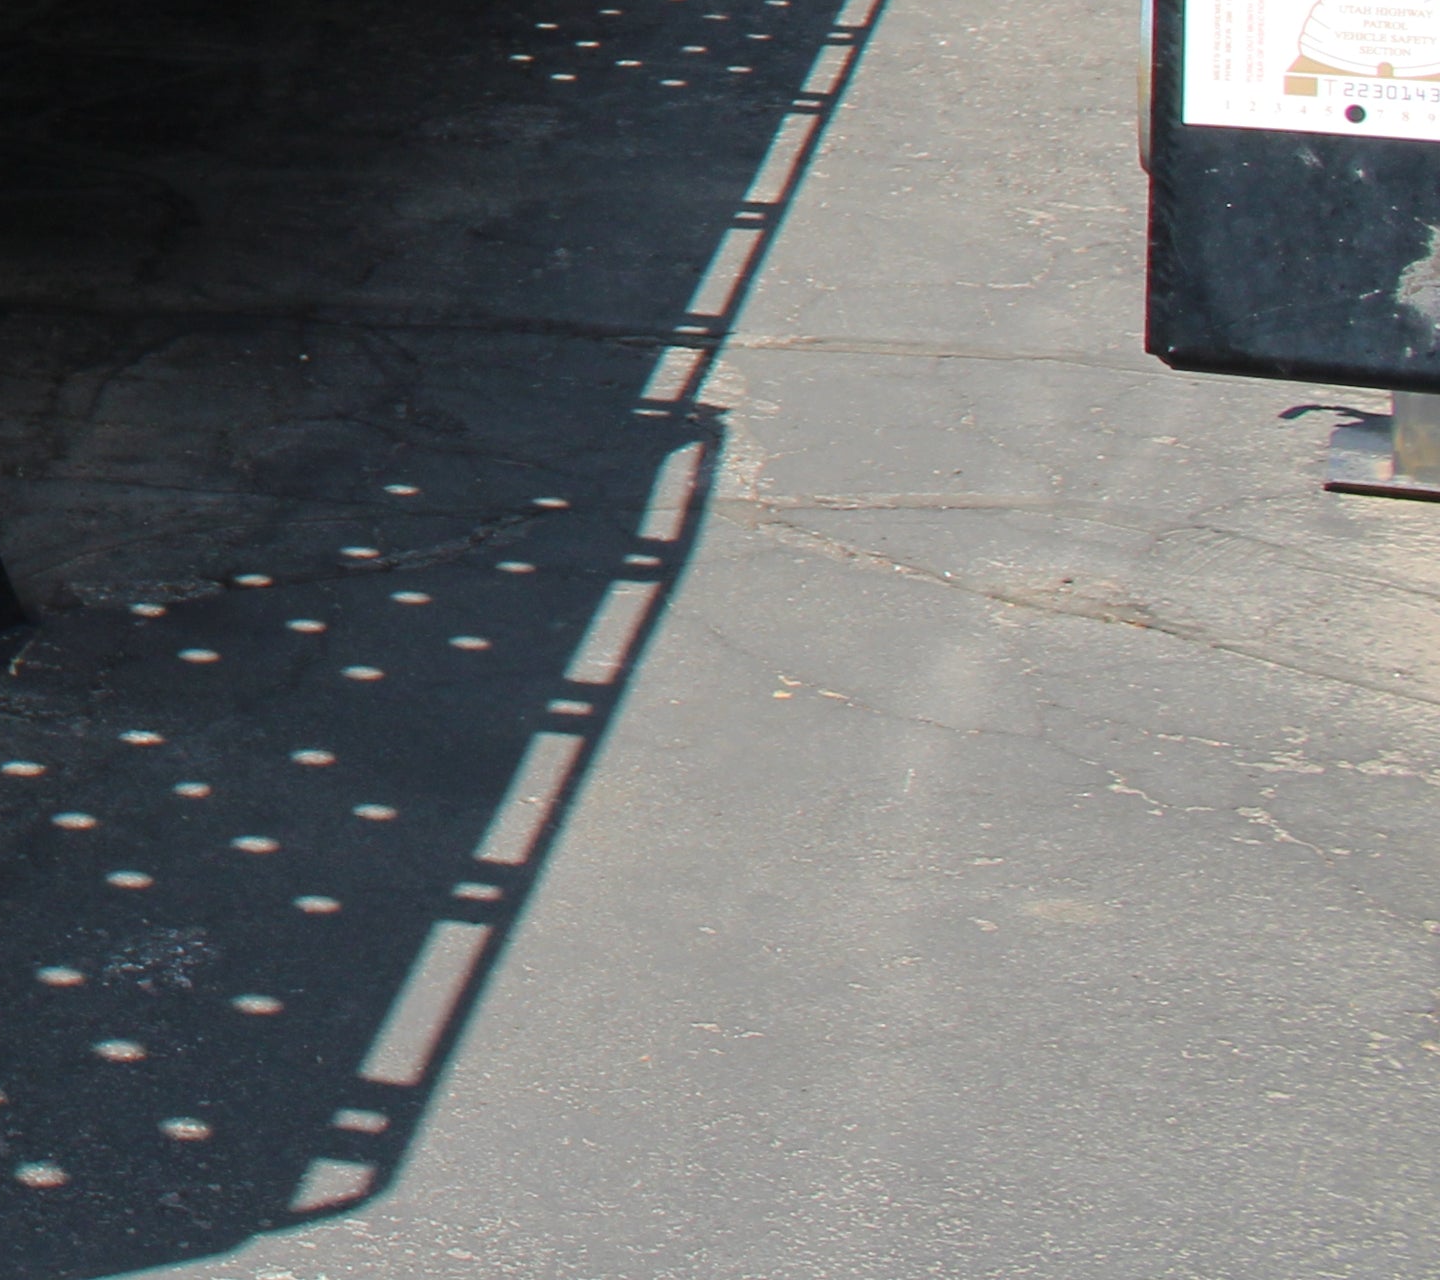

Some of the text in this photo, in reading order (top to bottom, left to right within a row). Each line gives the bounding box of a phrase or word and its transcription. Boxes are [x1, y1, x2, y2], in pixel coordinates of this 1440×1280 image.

[1247, 3, 1255, 33] MONTH
[1338, 4, 1434, 19] UTAH HIGHWAY
[1362, 19, 1409, 31] PATROL
[1246, 34, 1255, 52] OUT
[1334, 30, 1438, 46] VEHICLE SAFETY
[1257, 47, 1265, 59] OF
[1359, 45, 1412, 57] SECTION
[1246, 53, 1255, 83] PUNCH
[1256, 61, 1265, 82] YEAR
